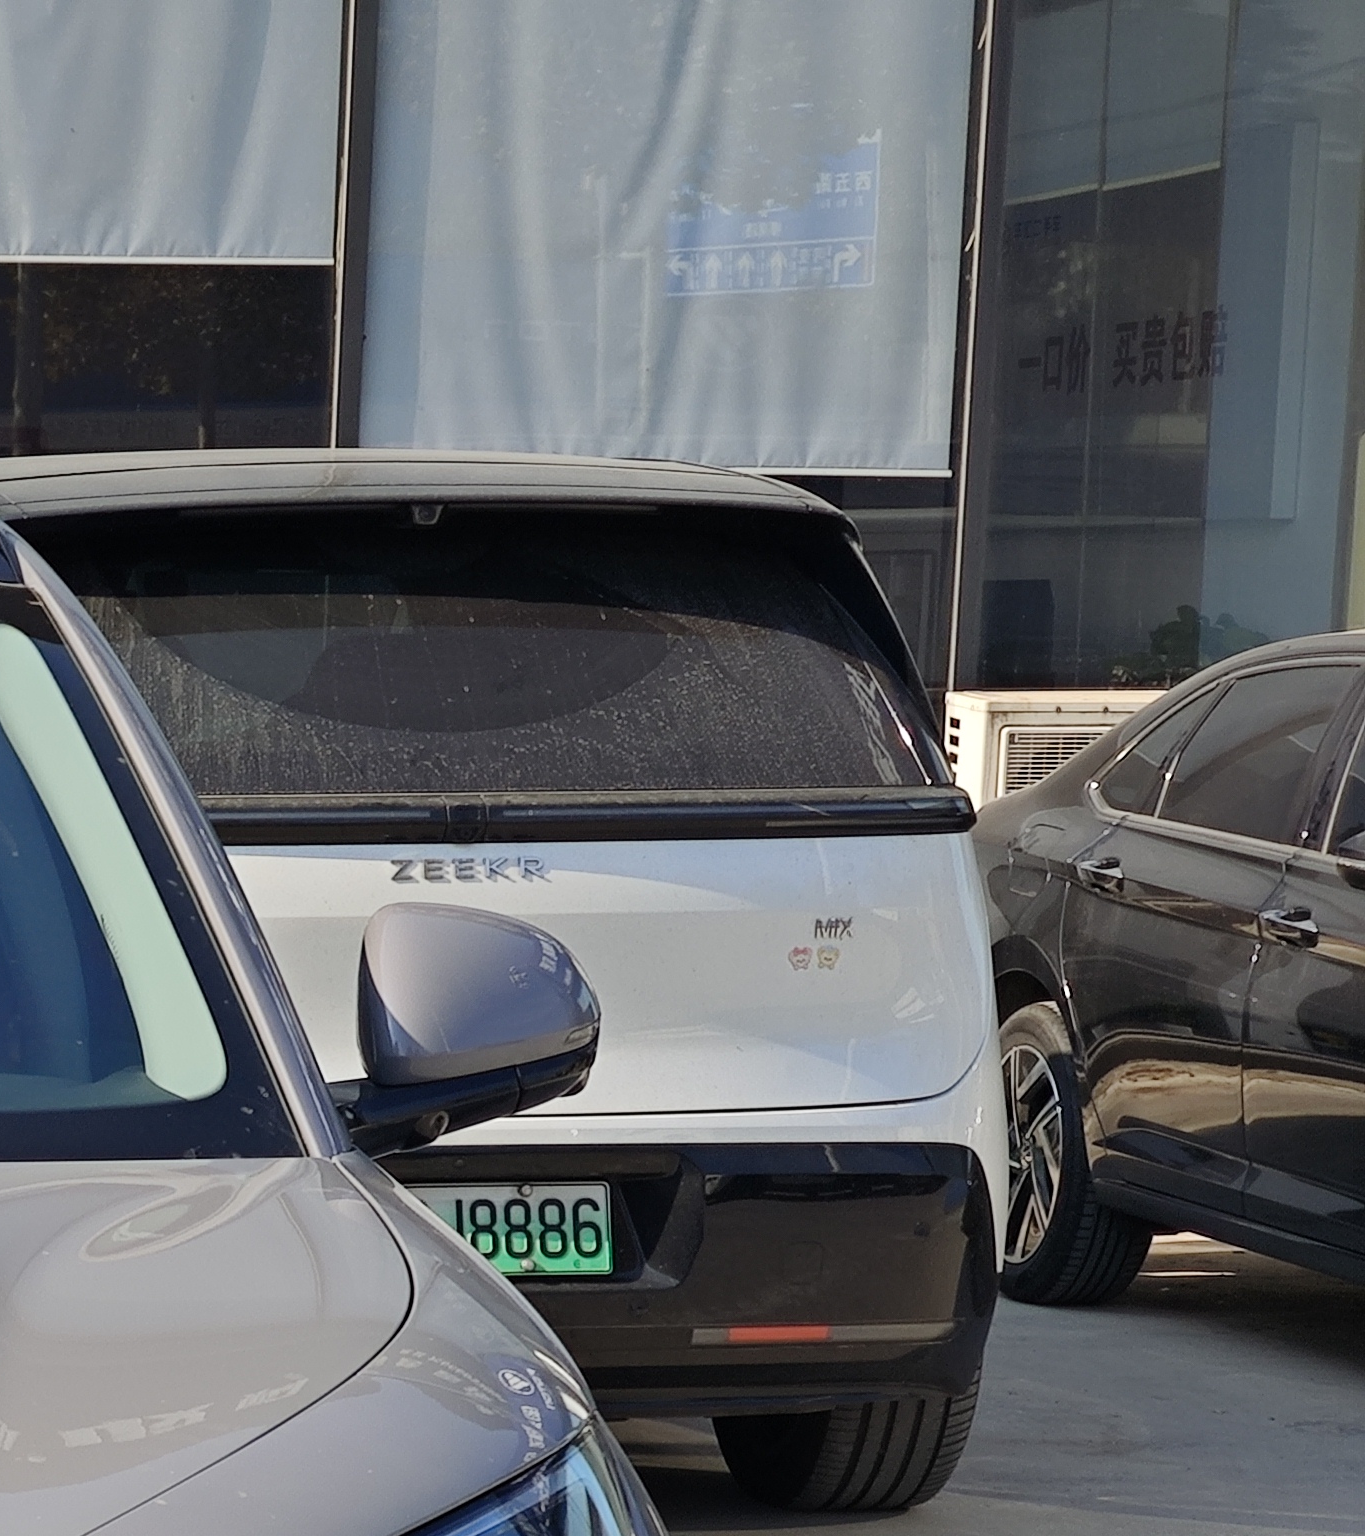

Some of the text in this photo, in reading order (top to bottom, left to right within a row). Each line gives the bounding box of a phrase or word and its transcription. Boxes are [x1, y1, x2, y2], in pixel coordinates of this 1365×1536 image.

[1019, 323, 1091, 395] 一口价
[1112, 305, 1228, 388] 买贵包赔
[390, 856, 551, 883] ZEEKR
[814, 916, 854, 941] MIX
